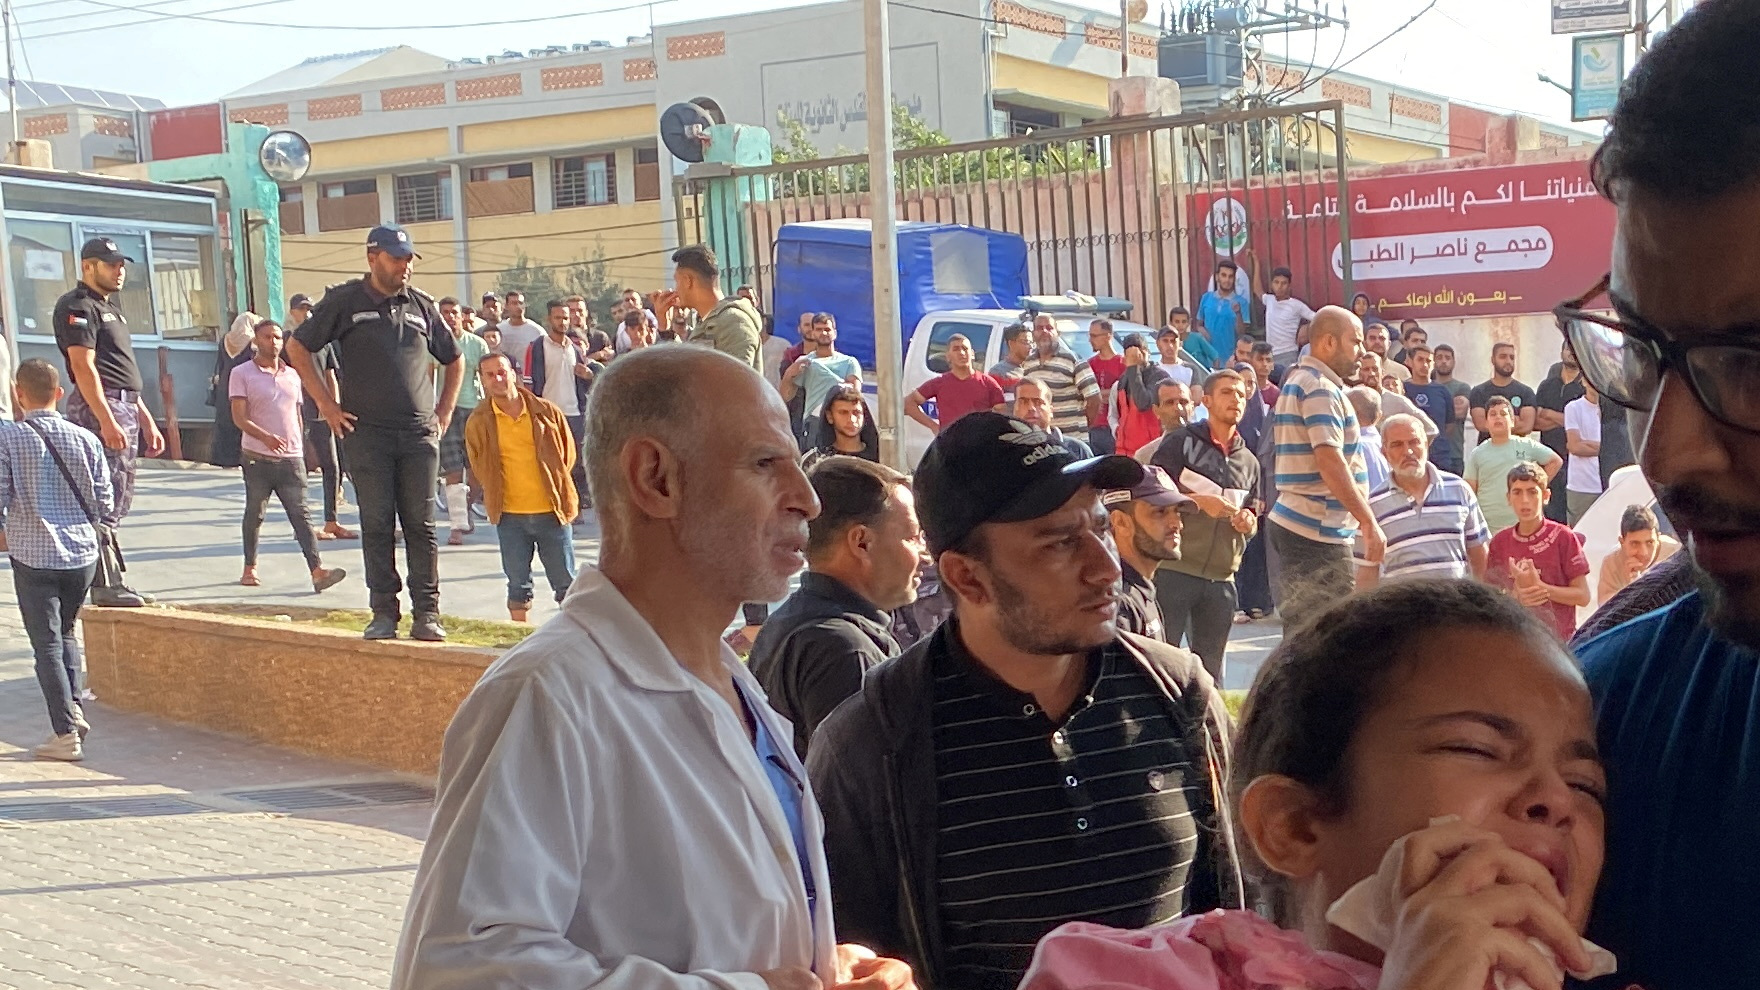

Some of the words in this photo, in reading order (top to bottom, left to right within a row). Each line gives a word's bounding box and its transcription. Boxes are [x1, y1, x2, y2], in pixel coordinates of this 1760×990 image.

[1354, 185, 1456, 214] بالسلامة
[1461, 182, 1513, 215] لكم
[1520, 177, 1599, 204] منياتنا
[1410, 237, 1468, 265] ناصر
[1474, 237, 1547, 263] مجمع
[1435, 285, 1454, 304] الله
[1457, 290, 1507, 306] بعون
